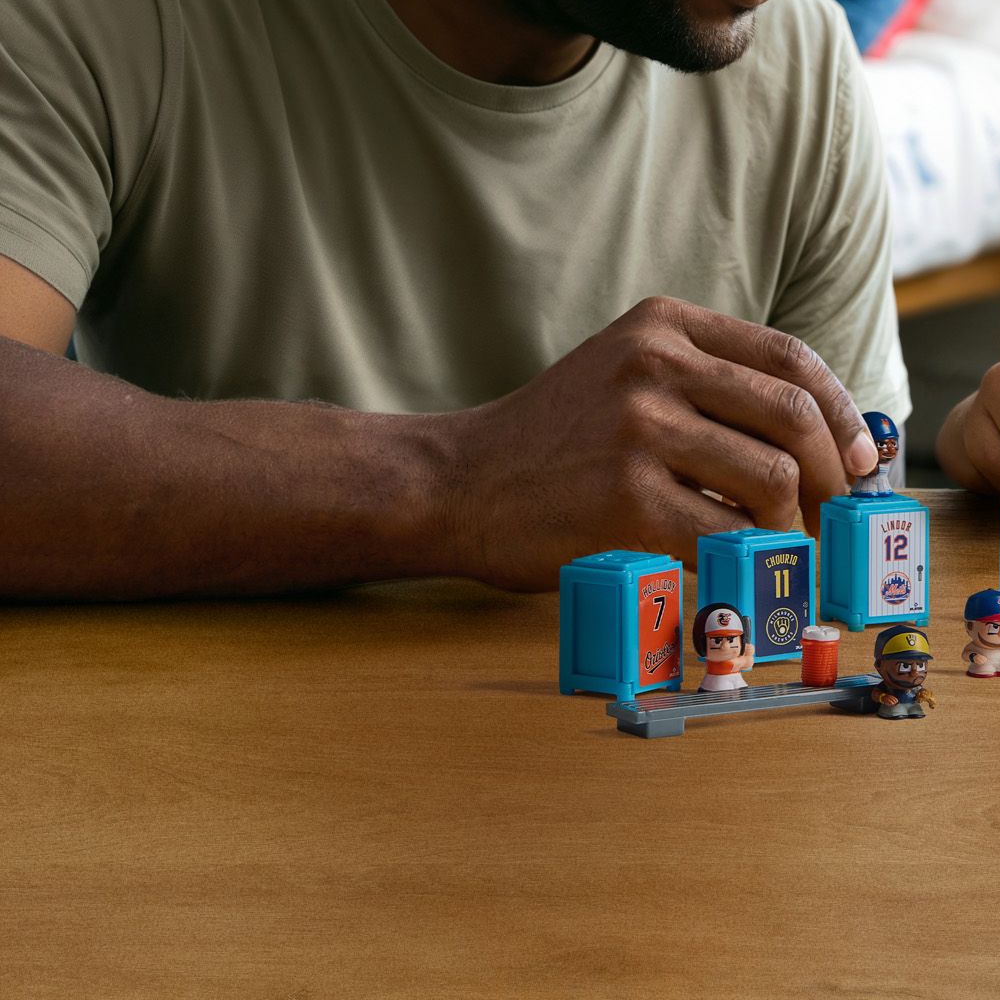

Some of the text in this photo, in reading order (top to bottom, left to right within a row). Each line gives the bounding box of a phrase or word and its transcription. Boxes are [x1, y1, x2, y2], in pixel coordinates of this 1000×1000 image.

[881, 519, 912, 533] LINDOR
[765, 553, 799, 569] CHOURIO
[884, 534, 908, 562] 12
[774, 569, 790, 598] 11
[653, 595, 666, 632] 7
